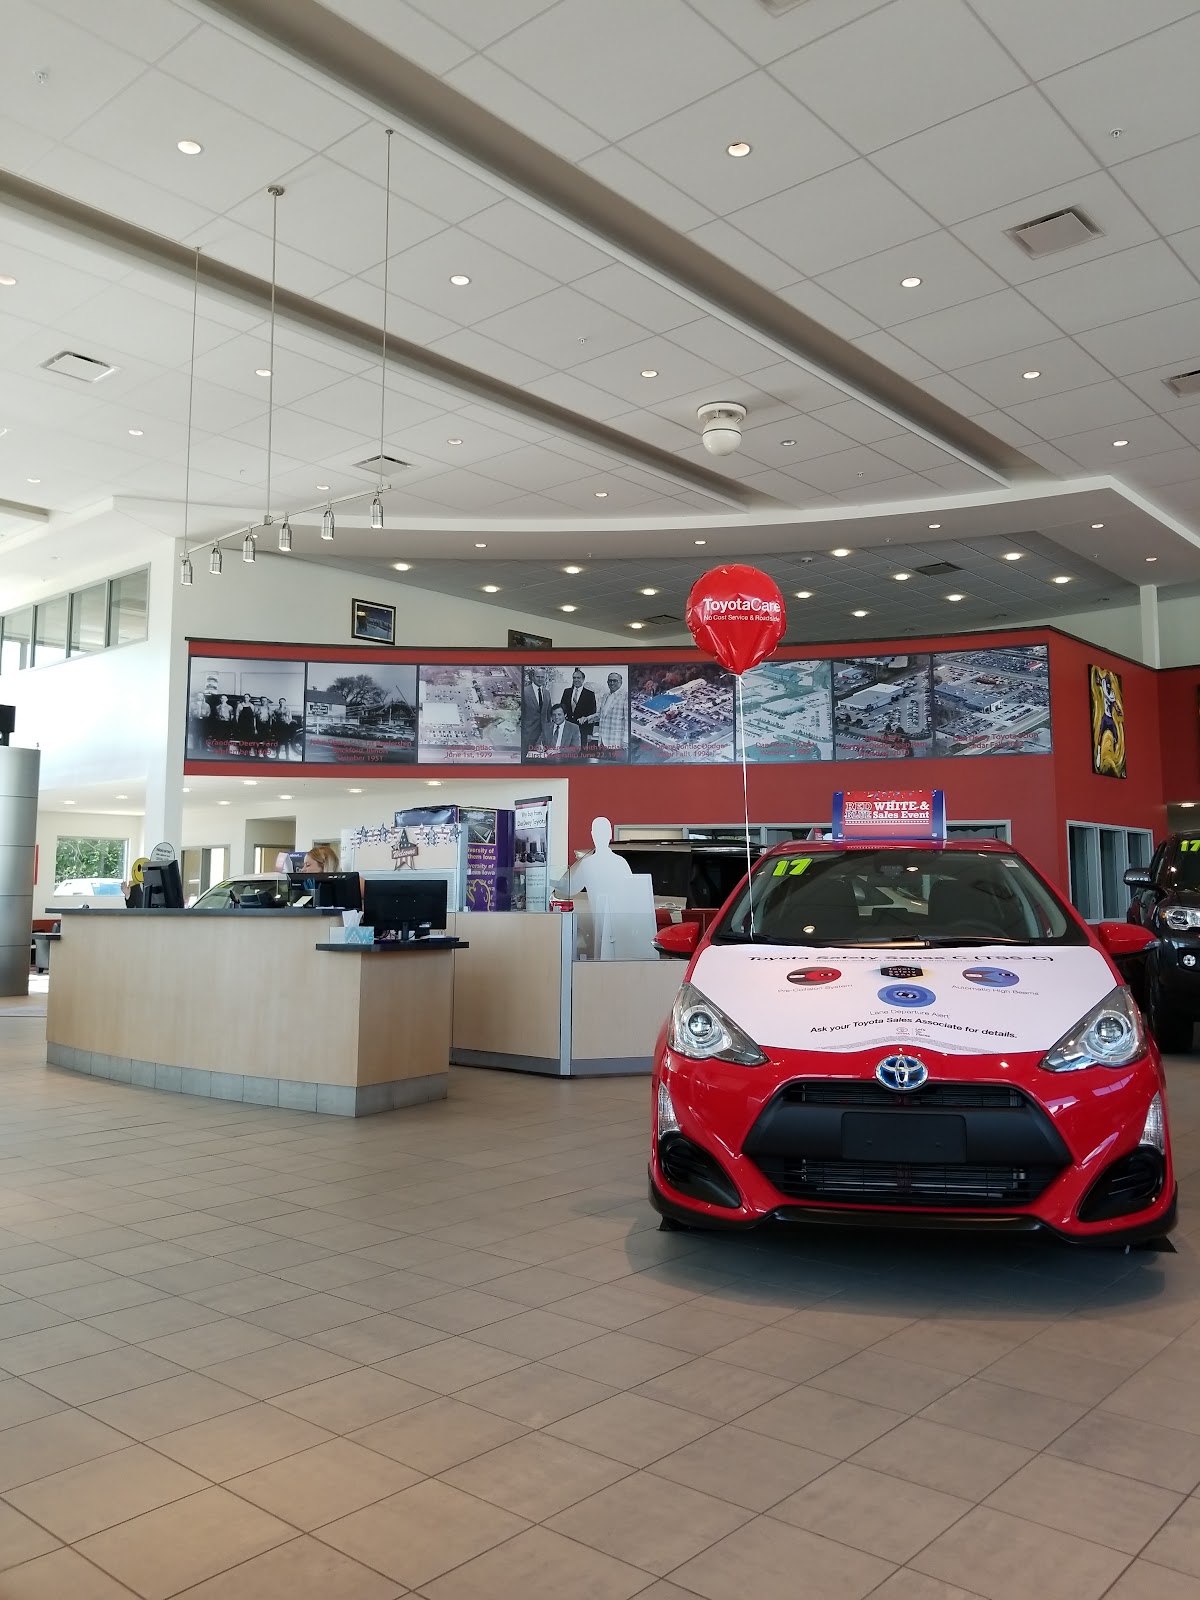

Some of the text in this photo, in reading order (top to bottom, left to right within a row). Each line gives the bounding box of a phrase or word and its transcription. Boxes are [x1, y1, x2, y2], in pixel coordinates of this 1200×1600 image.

[703, 598, 780, 613] ToyotaCare
[845, 802, 930, 811] RED WHITE &
[873, 811, 899, 819] Sales
[901, 811, 930, 819] Event
[1181, 840, 1200, 852] 17
[773, 857, 814, 876] 17
[951, 984, 990, 992] Automatic
[829, 1024, 851, 1032] your
[853, 1019, 884, 1028] Toyota
[915, 1018, 963, 1031] Associate
[981, 1029, 1018, 1039] details.
